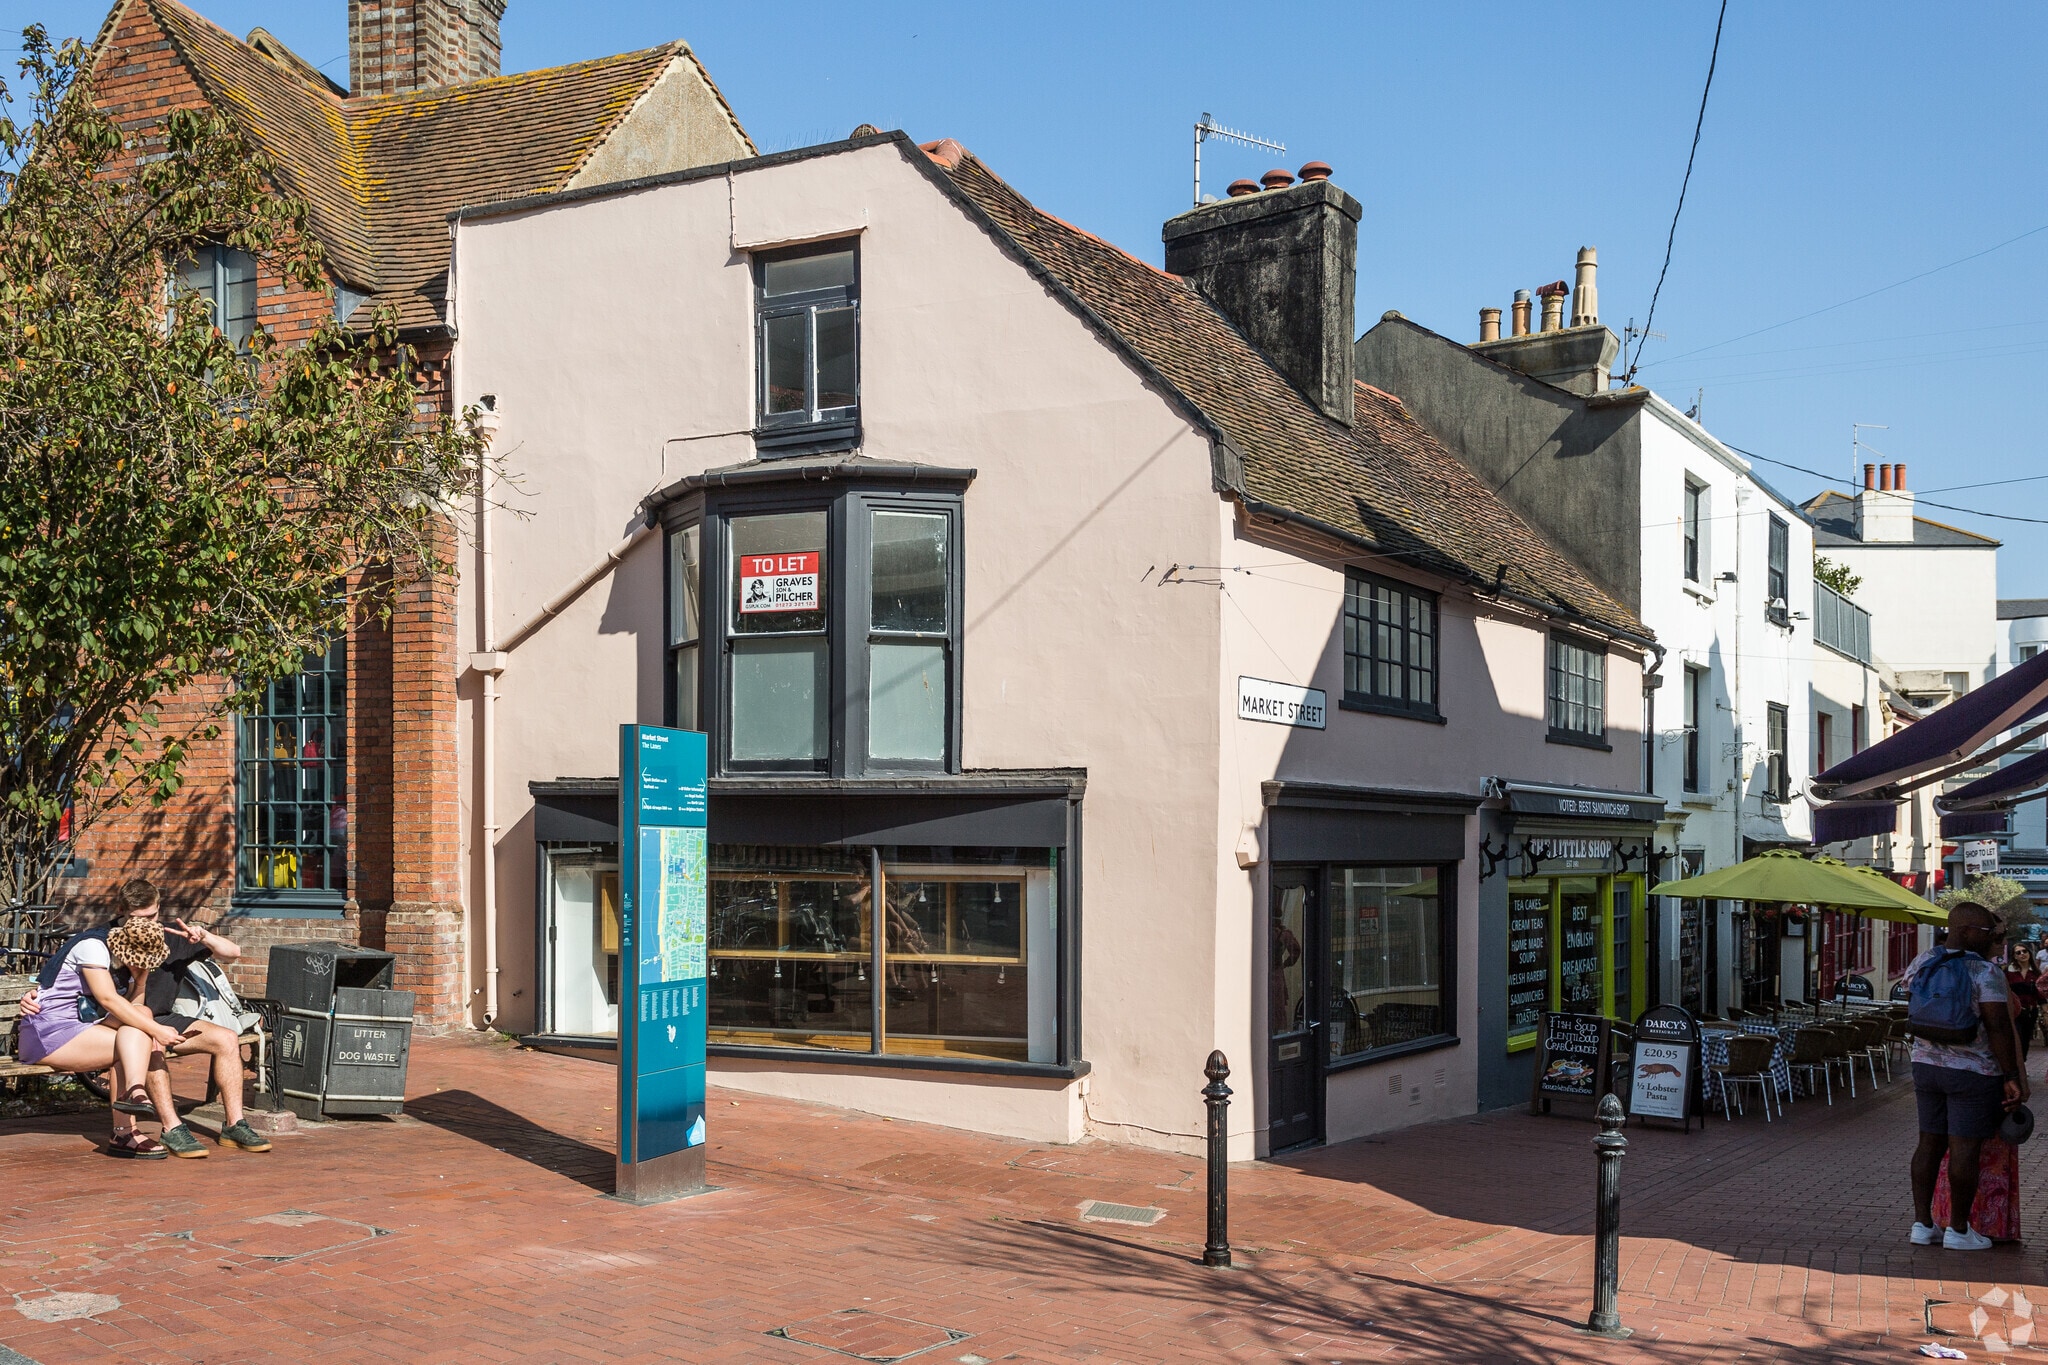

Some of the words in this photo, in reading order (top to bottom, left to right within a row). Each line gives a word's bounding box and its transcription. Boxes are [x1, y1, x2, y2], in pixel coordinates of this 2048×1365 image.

[752, 558, 774, 573] TO
[778, 556, 807, 572] LET
[776, 577, 813, 587] GRAVES
[776, 592, 813, 602] PILCHER
[1242, 695, 1284, 717] MARKET
[1288, 703, 1322, 722] STREET
[1558, 799, 1577, 812] VOTED:
[1578, 801, 1591, 813] BEST
[1592, 802, 1616, 815] SANDWICH
[1616, 804, 1630, 816] SHOP
[1553, 839, 1586, 858] LITTLE
[1588, 840, 1612, 858] SHOP
[1966, 850, 1978, 858] SHOP
[1514, 900, 1524, 911] TEA
[1525, 899, 1541, 910] CAKES
[1572, 906, 1587, 921] BEST
[1512, 920, 1530, 931] CREAM
[1531, 918, 1543, 929] TEAS
[1511, 939, 1527, 952] HOME
[1528, 937, 1543, 949] MADE
[1567, 932, 1594, 949] ENGLISH
[1519, 952, 1536, 964] SOUPS
[1562, 958, 1597, 976] BREAKFAST
[1526, 970, 1547, 981] RAREBIT
[1510, 989, 1544, 1006] SANDWICHES
[1572, 984, 1590, 1002] £6.45
[1516, 1010, 1539, 1024] TOASTIES
[1645, 1020, 1687, 1030] DARCY'S
[354, 1030, 386, 1039] LITTER
[339, 1052, 360, 1060] DOG
[363, 1053, 396, 1062] WASTE
[1644, 1048, 1678, 1059] £20.95
[1647, 1083, 1678, 1093] Lobster
[1646, 1092, 1667, 1101] Pasta
